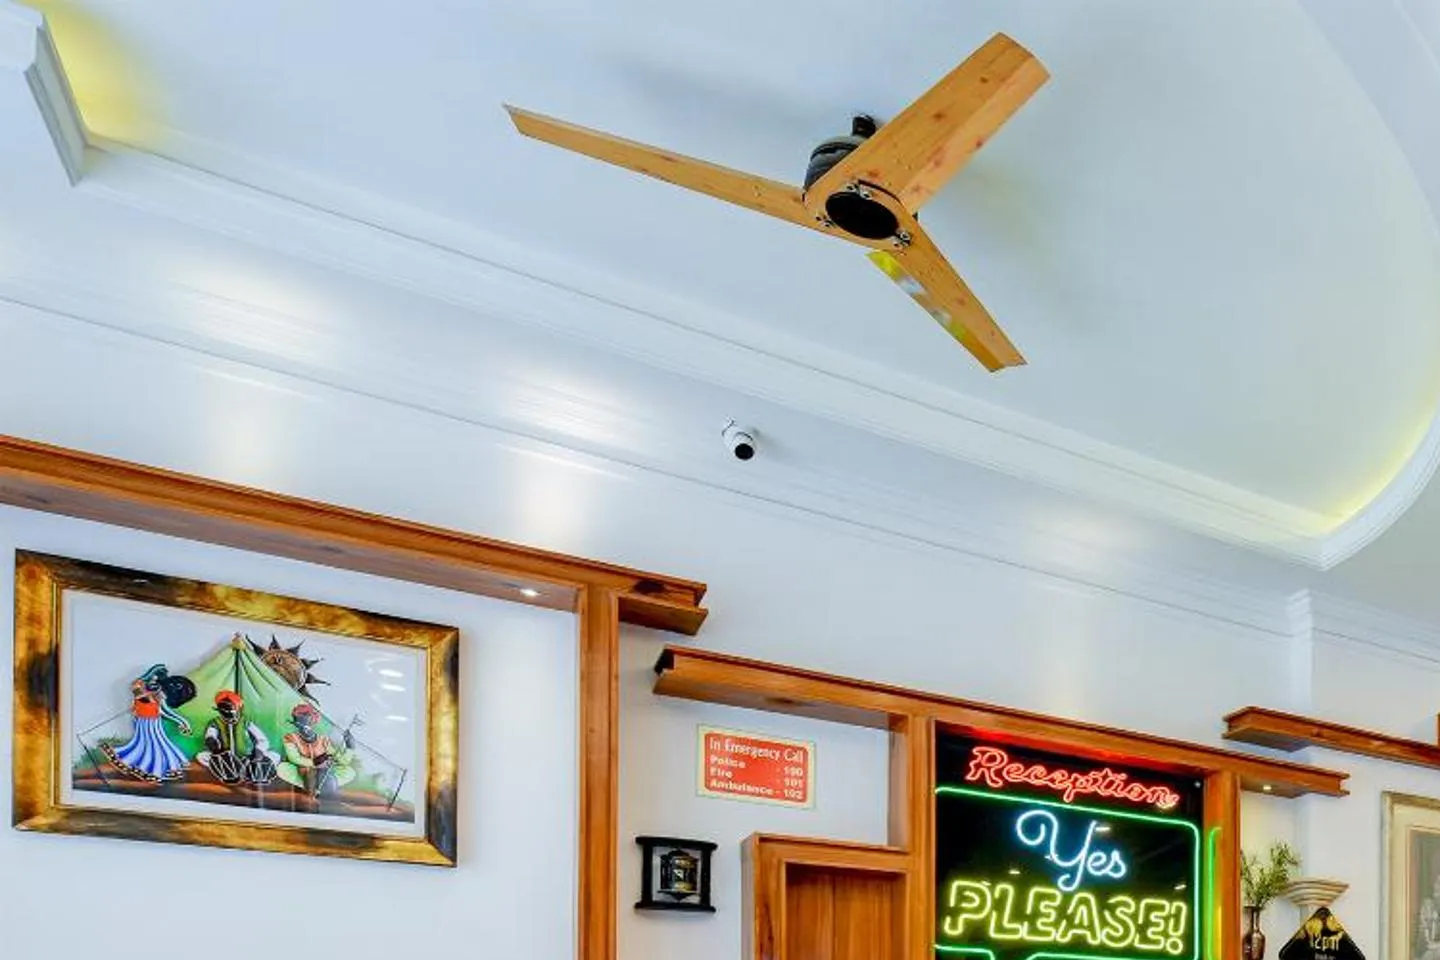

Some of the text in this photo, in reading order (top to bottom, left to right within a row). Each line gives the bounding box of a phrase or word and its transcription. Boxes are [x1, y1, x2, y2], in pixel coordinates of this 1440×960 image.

[709, 736, 721, 751] In
[709, 754, 746, 769] Police
[709, 778, 773, 796] Ambulance
[965, 746, 1180, 808] Reception
[1015, 809, 1127, 892] Yes
[943, 879, 1188, 956] PLEASE!
